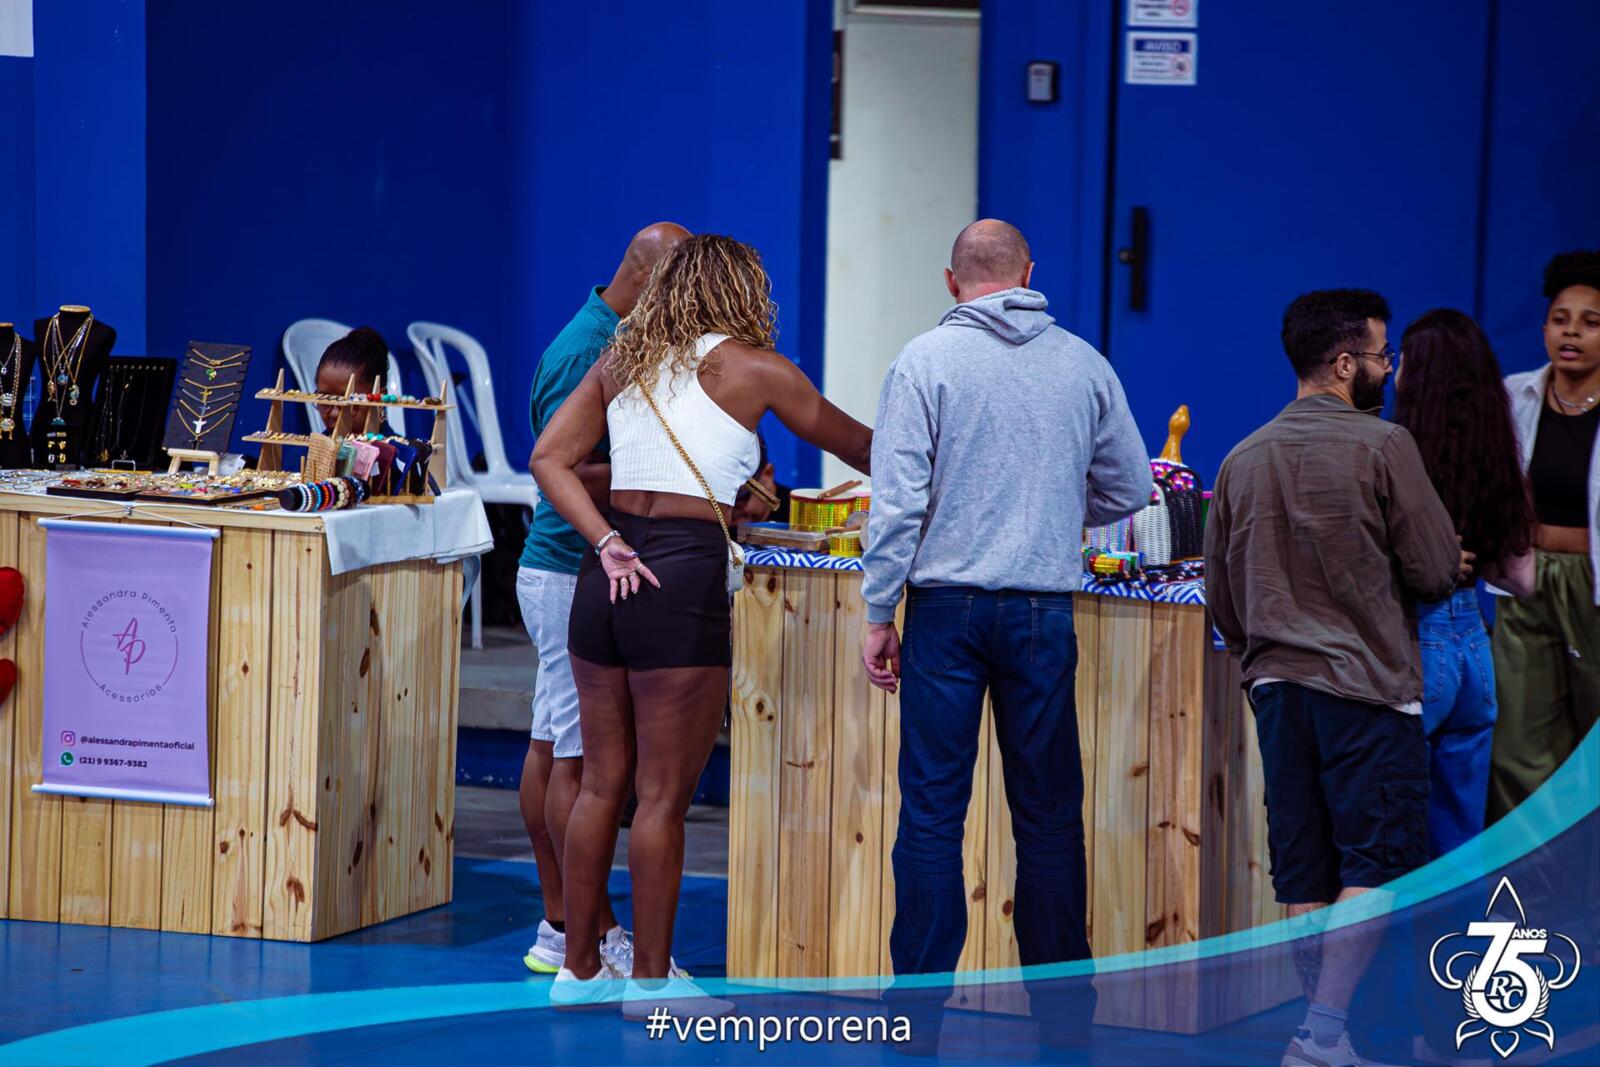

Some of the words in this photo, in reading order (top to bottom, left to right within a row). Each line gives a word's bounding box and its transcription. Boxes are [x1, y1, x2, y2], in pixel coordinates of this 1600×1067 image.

[1148, 40, 1182, 52] AVISO
[82, 590, 137, 629] Alessandra
[142, 593, 177, 633] Pimenta
[99, 684, 162, 703] Acessórios
[80, 735, 195, 750] @alessandrapimentaoficial
[79, 756, 96, 766] (21)
[97, 757, 102, 766] 9
[103, 758, 148, 768] 9367-9382
